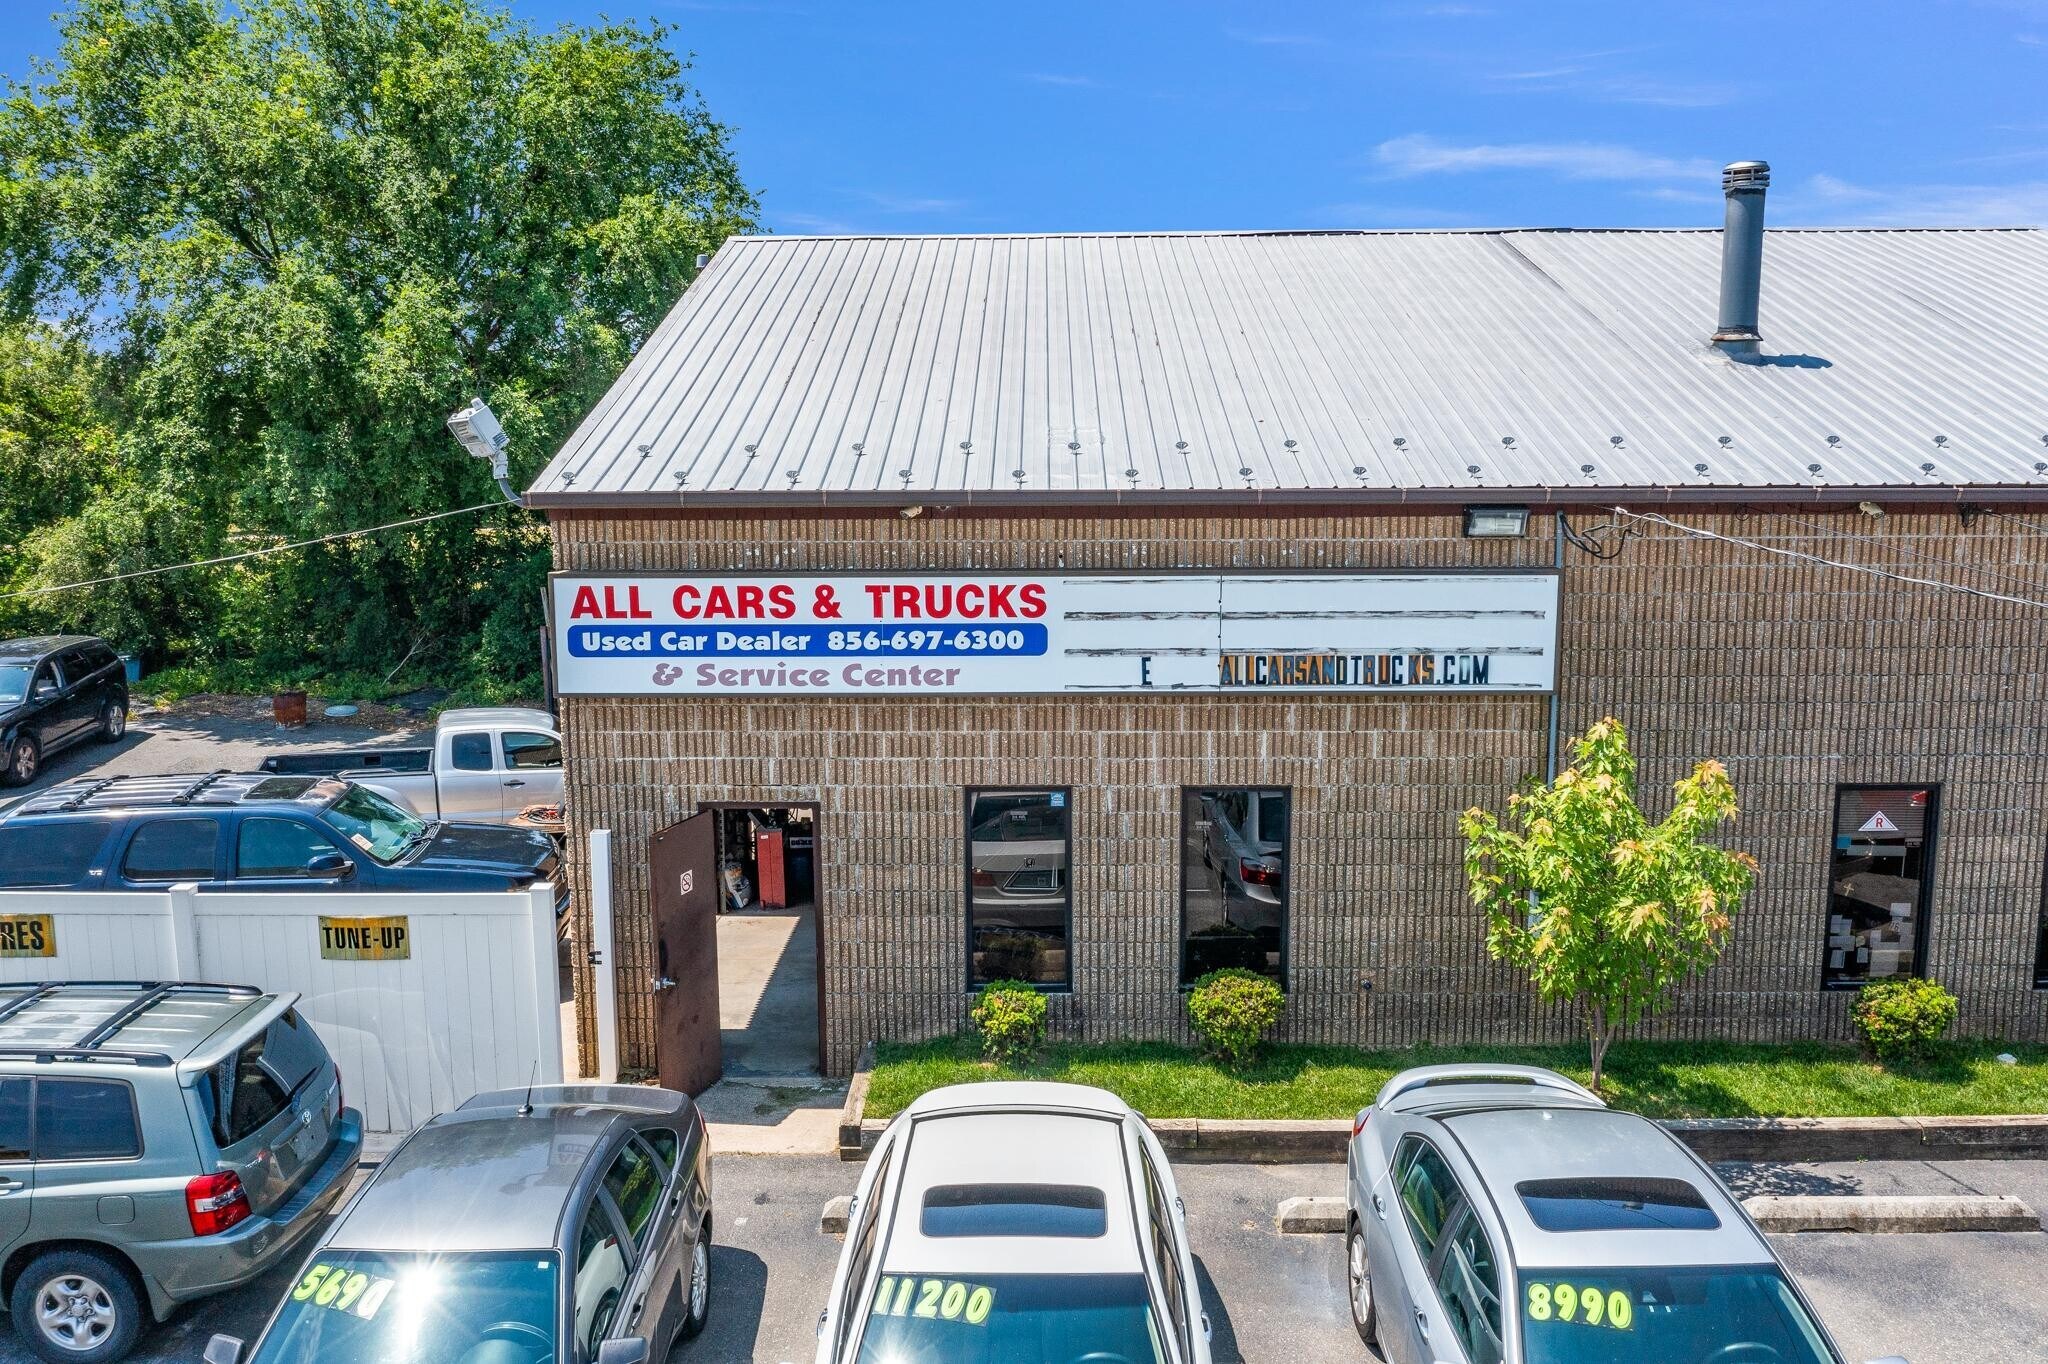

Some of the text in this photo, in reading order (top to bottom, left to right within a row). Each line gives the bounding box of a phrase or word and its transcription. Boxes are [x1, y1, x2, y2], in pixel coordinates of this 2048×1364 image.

[570, 584, 1047, 619] ALL CARS & TRUCKS
[582, 630, 1024, 651] Used Car Dealer 856-697-6300
[652, 661, 961, 687] & Service Center
[1141, 655, 1489, 685] E ALLCARSANDTRUCKS.COM
[1875, 817, 1884, 828] R
[322, 926, 405, 949] TUNE-UP
[293, 1264, 393, 1319] 5690
[874, 1277, 993, 1324] 11200
[1528, 1283, 1632, 1329] 8990
